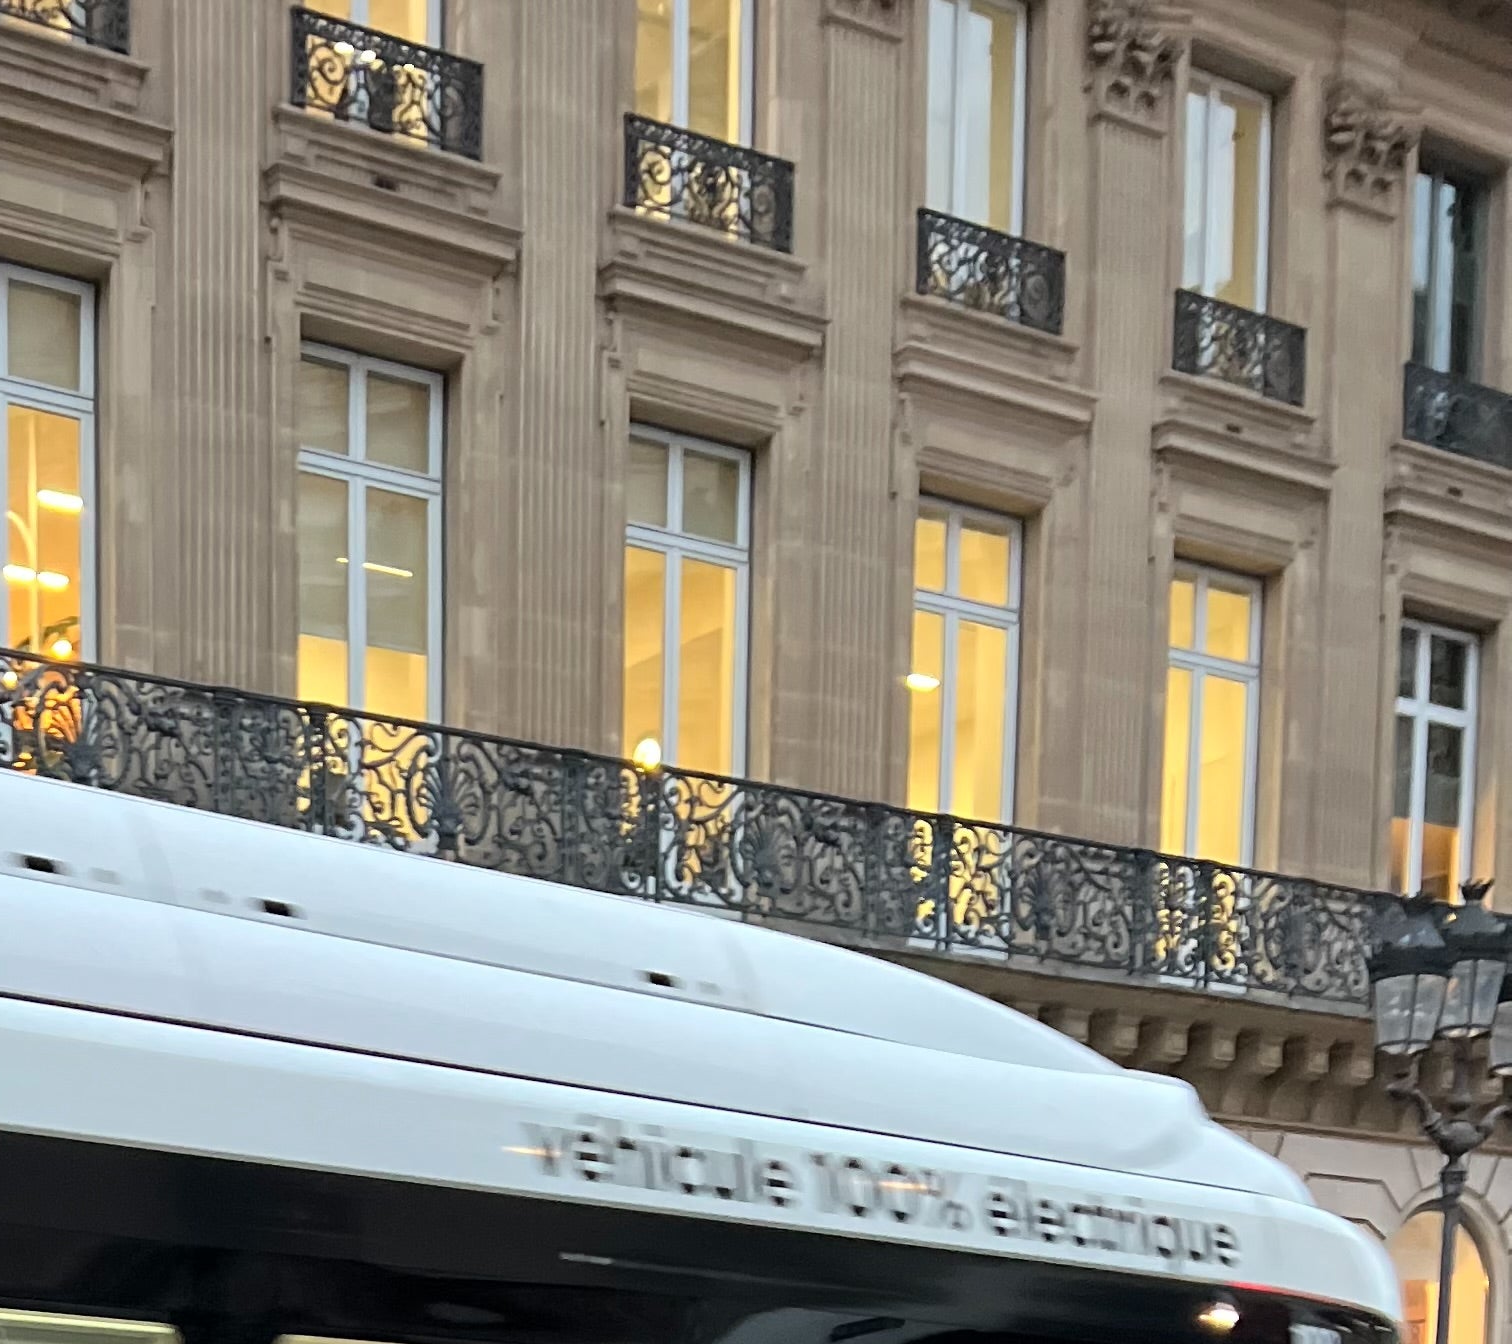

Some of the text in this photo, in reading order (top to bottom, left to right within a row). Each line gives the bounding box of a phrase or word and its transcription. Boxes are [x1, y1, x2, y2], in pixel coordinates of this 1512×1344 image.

[524, 1113, 1244, 1273] véhicule 100% électrique
